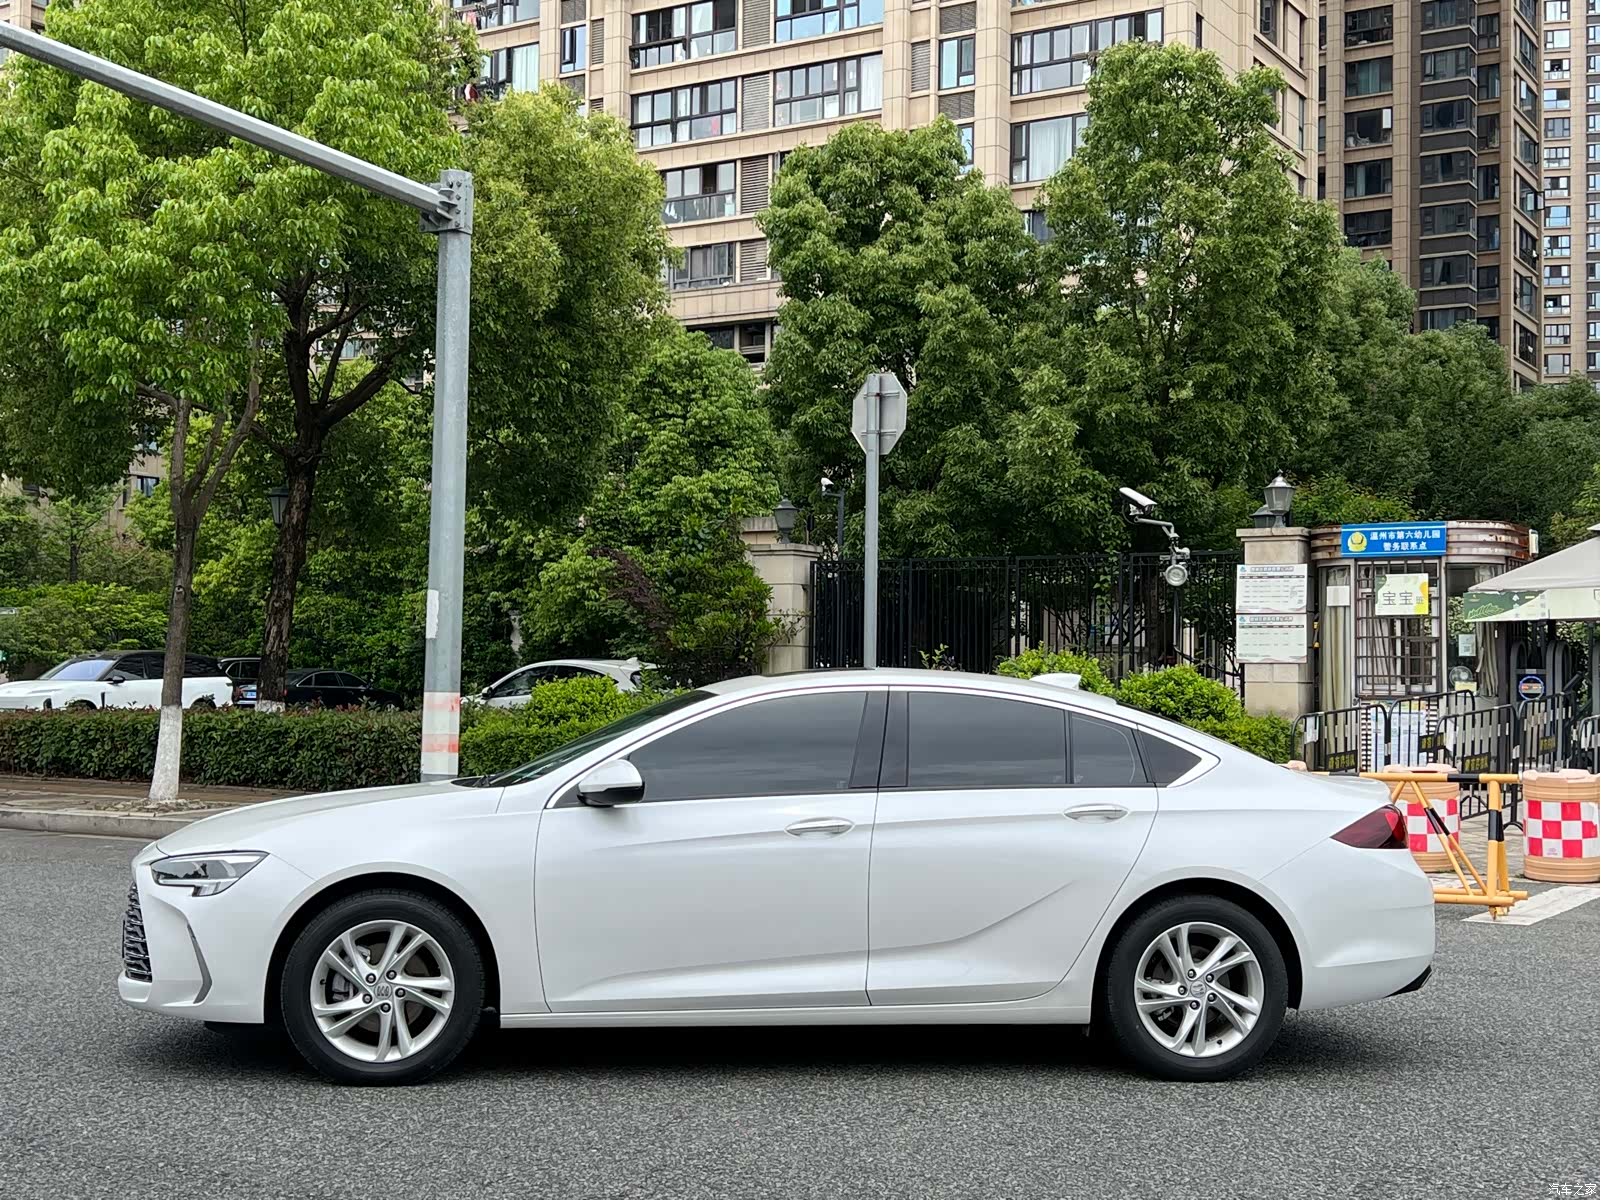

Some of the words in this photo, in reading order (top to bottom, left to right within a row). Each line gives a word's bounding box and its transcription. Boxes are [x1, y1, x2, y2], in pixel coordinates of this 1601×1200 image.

[1370, 530, 1440, 540] 温州市第六幼儿园
[1383, 541, 1427, 551] 警务联系点
